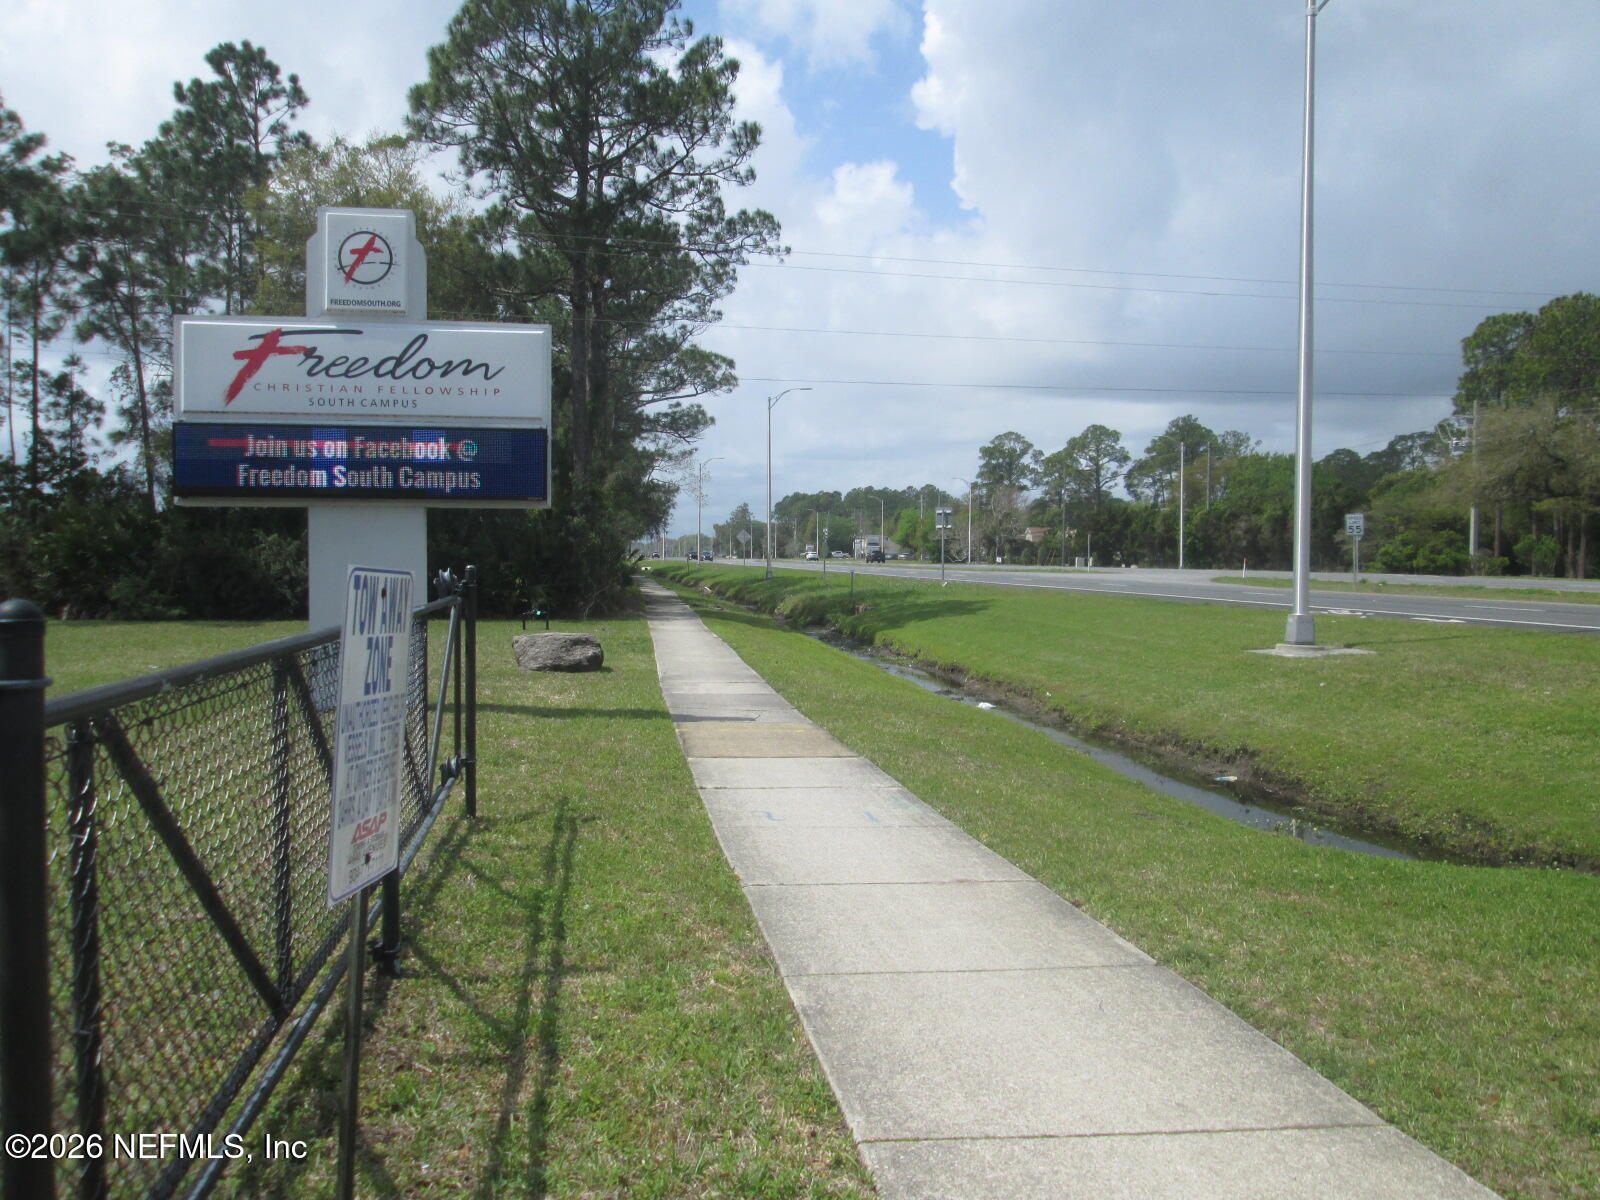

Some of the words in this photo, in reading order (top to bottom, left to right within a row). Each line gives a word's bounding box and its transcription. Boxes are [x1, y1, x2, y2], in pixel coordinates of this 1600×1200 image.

[330, 298, 401, 307] FREEDOMSOUTH.ORG
[224, 328, 506, 407] Freedom
[253, 382, 363, 394] CHRISTIAN
[377, 385, 501, 396] FELLOWSHIP
[308, 397, 355, 408] SOUTH
[361, 398, 418, 409] CAMPUS
[246, 434, 288, 458] Join
[293, 440, 318, 458] us
[322, 440, 348, 459] on
[353, 436, 451, 460] Facebook
[238, 464, 327, 488] Freedom
[332, 464, 394, 488] South
[399, 465, 481, 493] Campus
[1347, 525, 1361, 534] 55
[352, 574, 380, 636] TOW
[380, 576, 411, 634] AWAY
[364, 635, 394, 696] ZONE
[350, 811, 388, 845] ASAP
